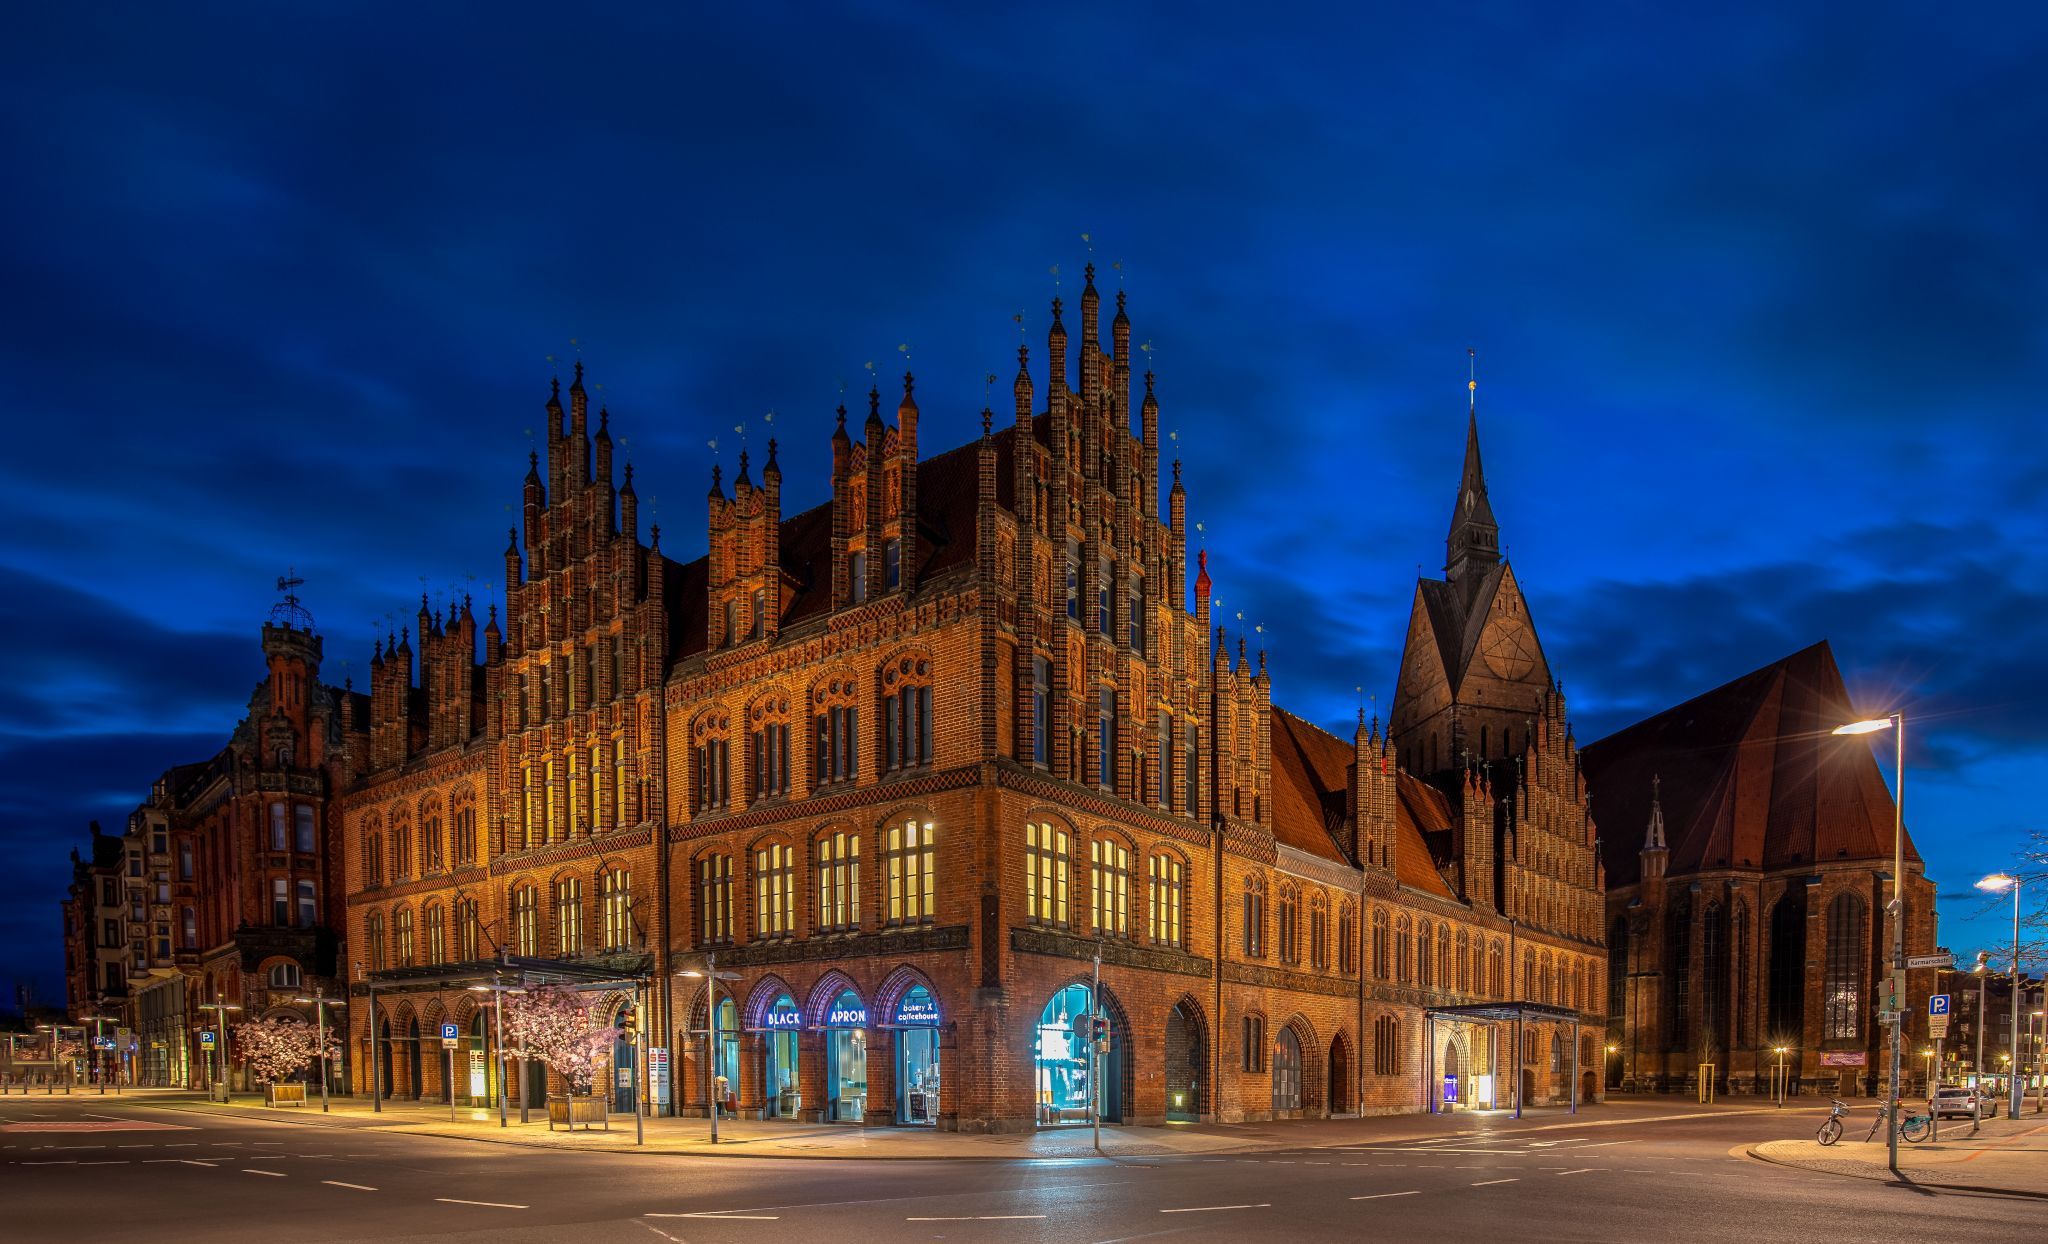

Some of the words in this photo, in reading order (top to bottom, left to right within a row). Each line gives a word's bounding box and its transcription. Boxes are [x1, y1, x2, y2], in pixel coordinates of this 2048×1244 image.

[768, 1013, 800, 1025] BLACK
[830, 1010, 866, 1023] APRON
[898, 1013, 938, 1021] coffeehouse
